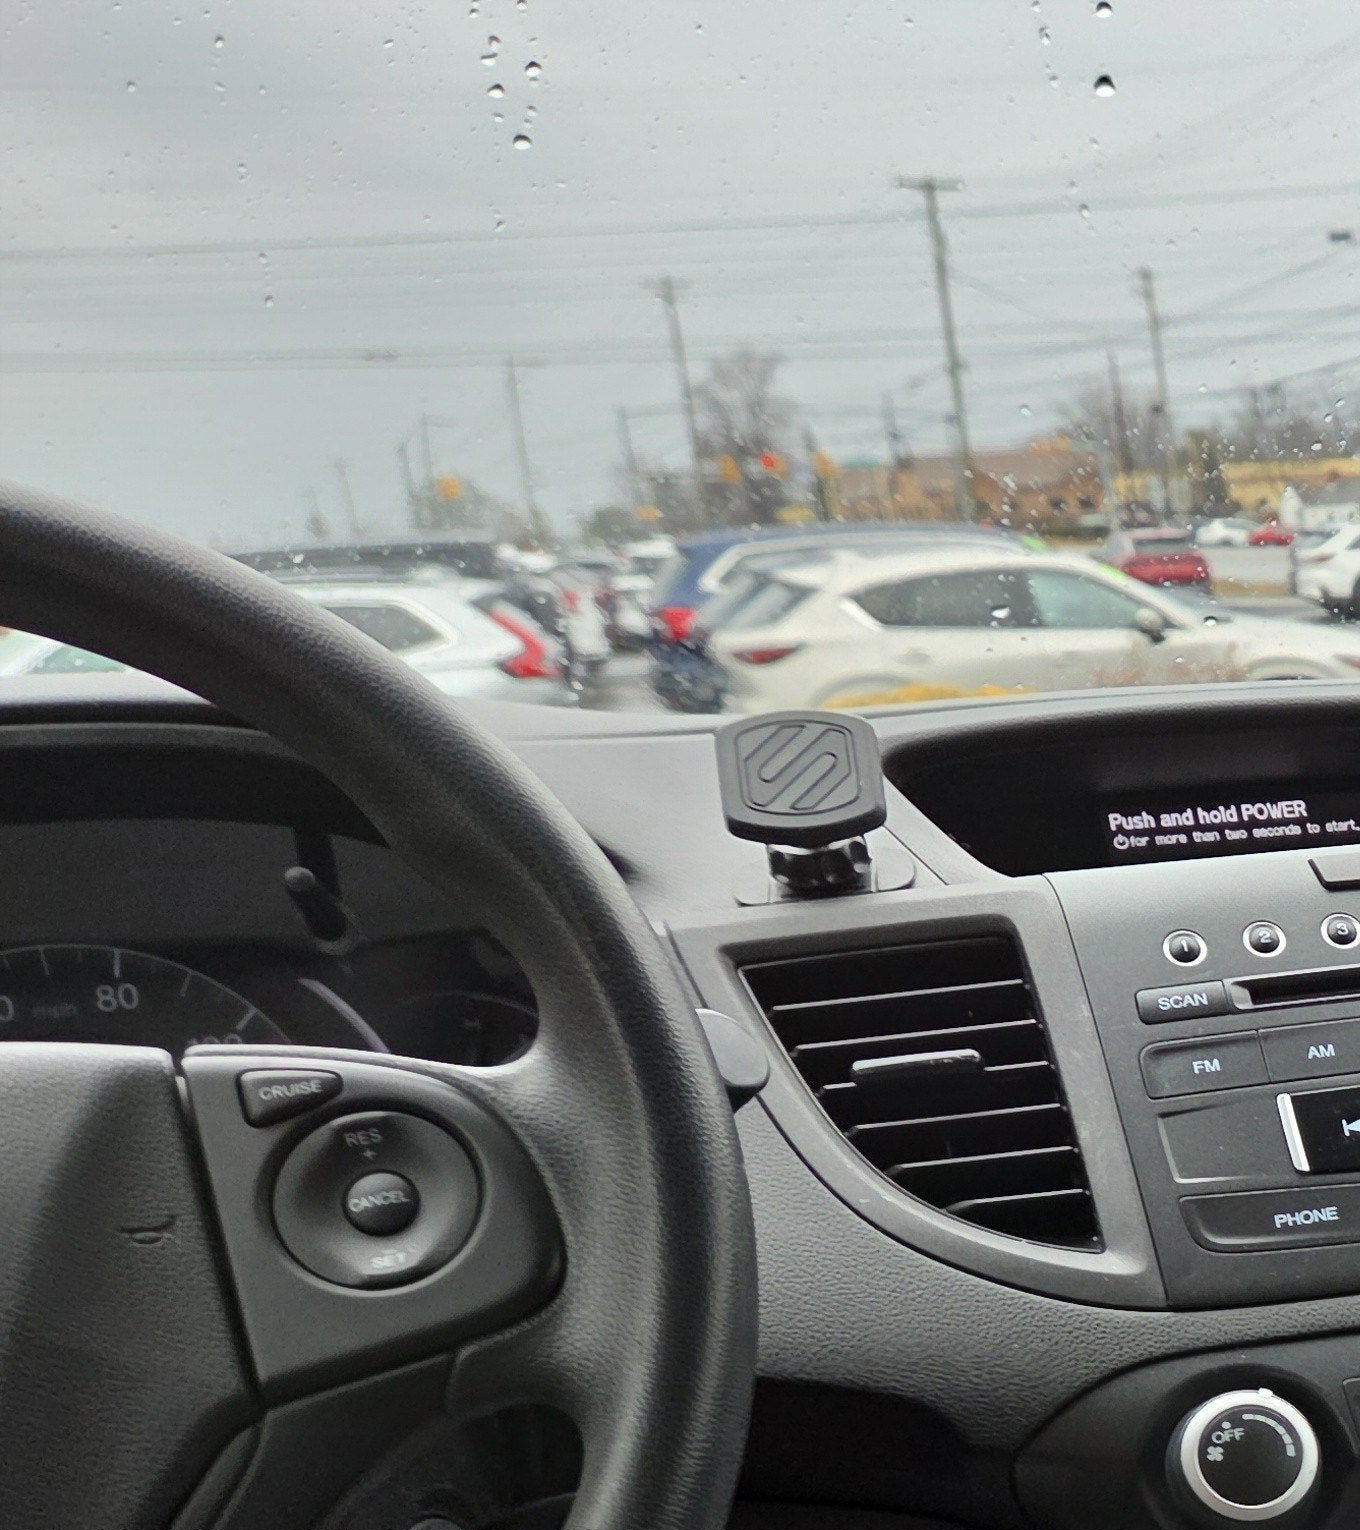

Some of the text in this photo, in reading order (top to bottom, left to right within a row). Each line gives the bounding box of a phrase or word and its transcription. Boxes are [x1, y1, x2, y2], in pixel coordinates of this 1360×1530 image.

[1108, 800, 1308, 831] Push and hold POWER
[1129, 835, 1150, 847] for
[1154, 833, 1188, 845] more
[1224, 828, 1248, 840] two
[1252, 823, 1302, 838] seconds
[1306, 823, 1321, 834] to
[1258, 929, 1272, 943] 2
[1337, 921, 1349, 935] 3
[1180, 939, 1189, 953] 1
[95, 982, 140, 1012] 80
[1157, 993, 1209, 1011] SCAN
[1307, 1043, 1336, 1060] AM
[1191, 1058, 1221, 1075] FM
[258, 1079, 324, 1101] CRUISE
[345, 1128, 384, 1147] RES
[349, 1190, 410, 1213] CANCEL
[1273, 1205, 1340, 1229] PHONE
[1211, 1427, 1246, 1444] OFF
